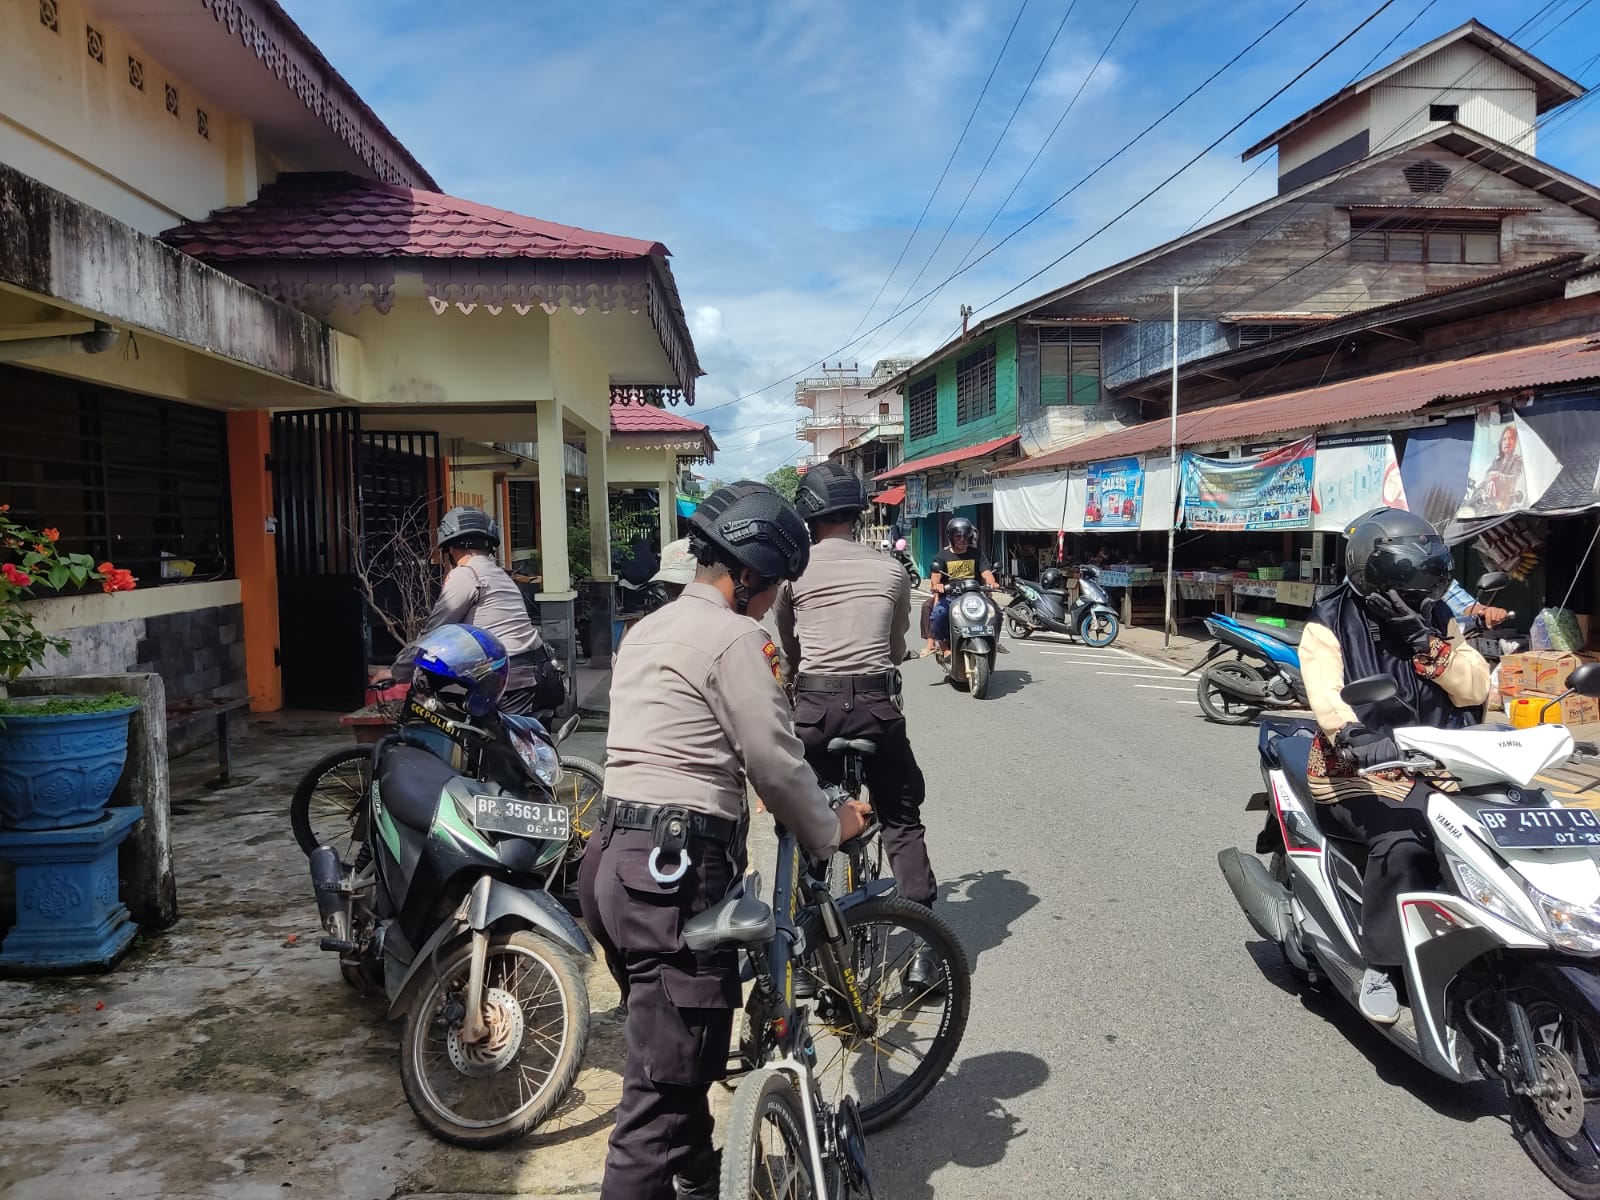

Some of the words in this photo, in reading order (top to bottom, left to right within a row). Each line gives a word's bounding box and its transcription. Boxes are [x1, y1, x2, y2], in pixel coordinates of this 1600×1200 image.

[424, 710, 455, 735] POLISI
[478, 798, 496, 813] BP
[505, 802, 541, 820] 3563
[548, 807, 566, 822] LC
[616, 807, 638, 822] OLRI
[1483, 813, 1507, 828] BP
[1520, 811, 1563, 827] 4171
[1435, 813, 1463, 840] YAMAHA
[843, 968, 863, 1014] POLISI
